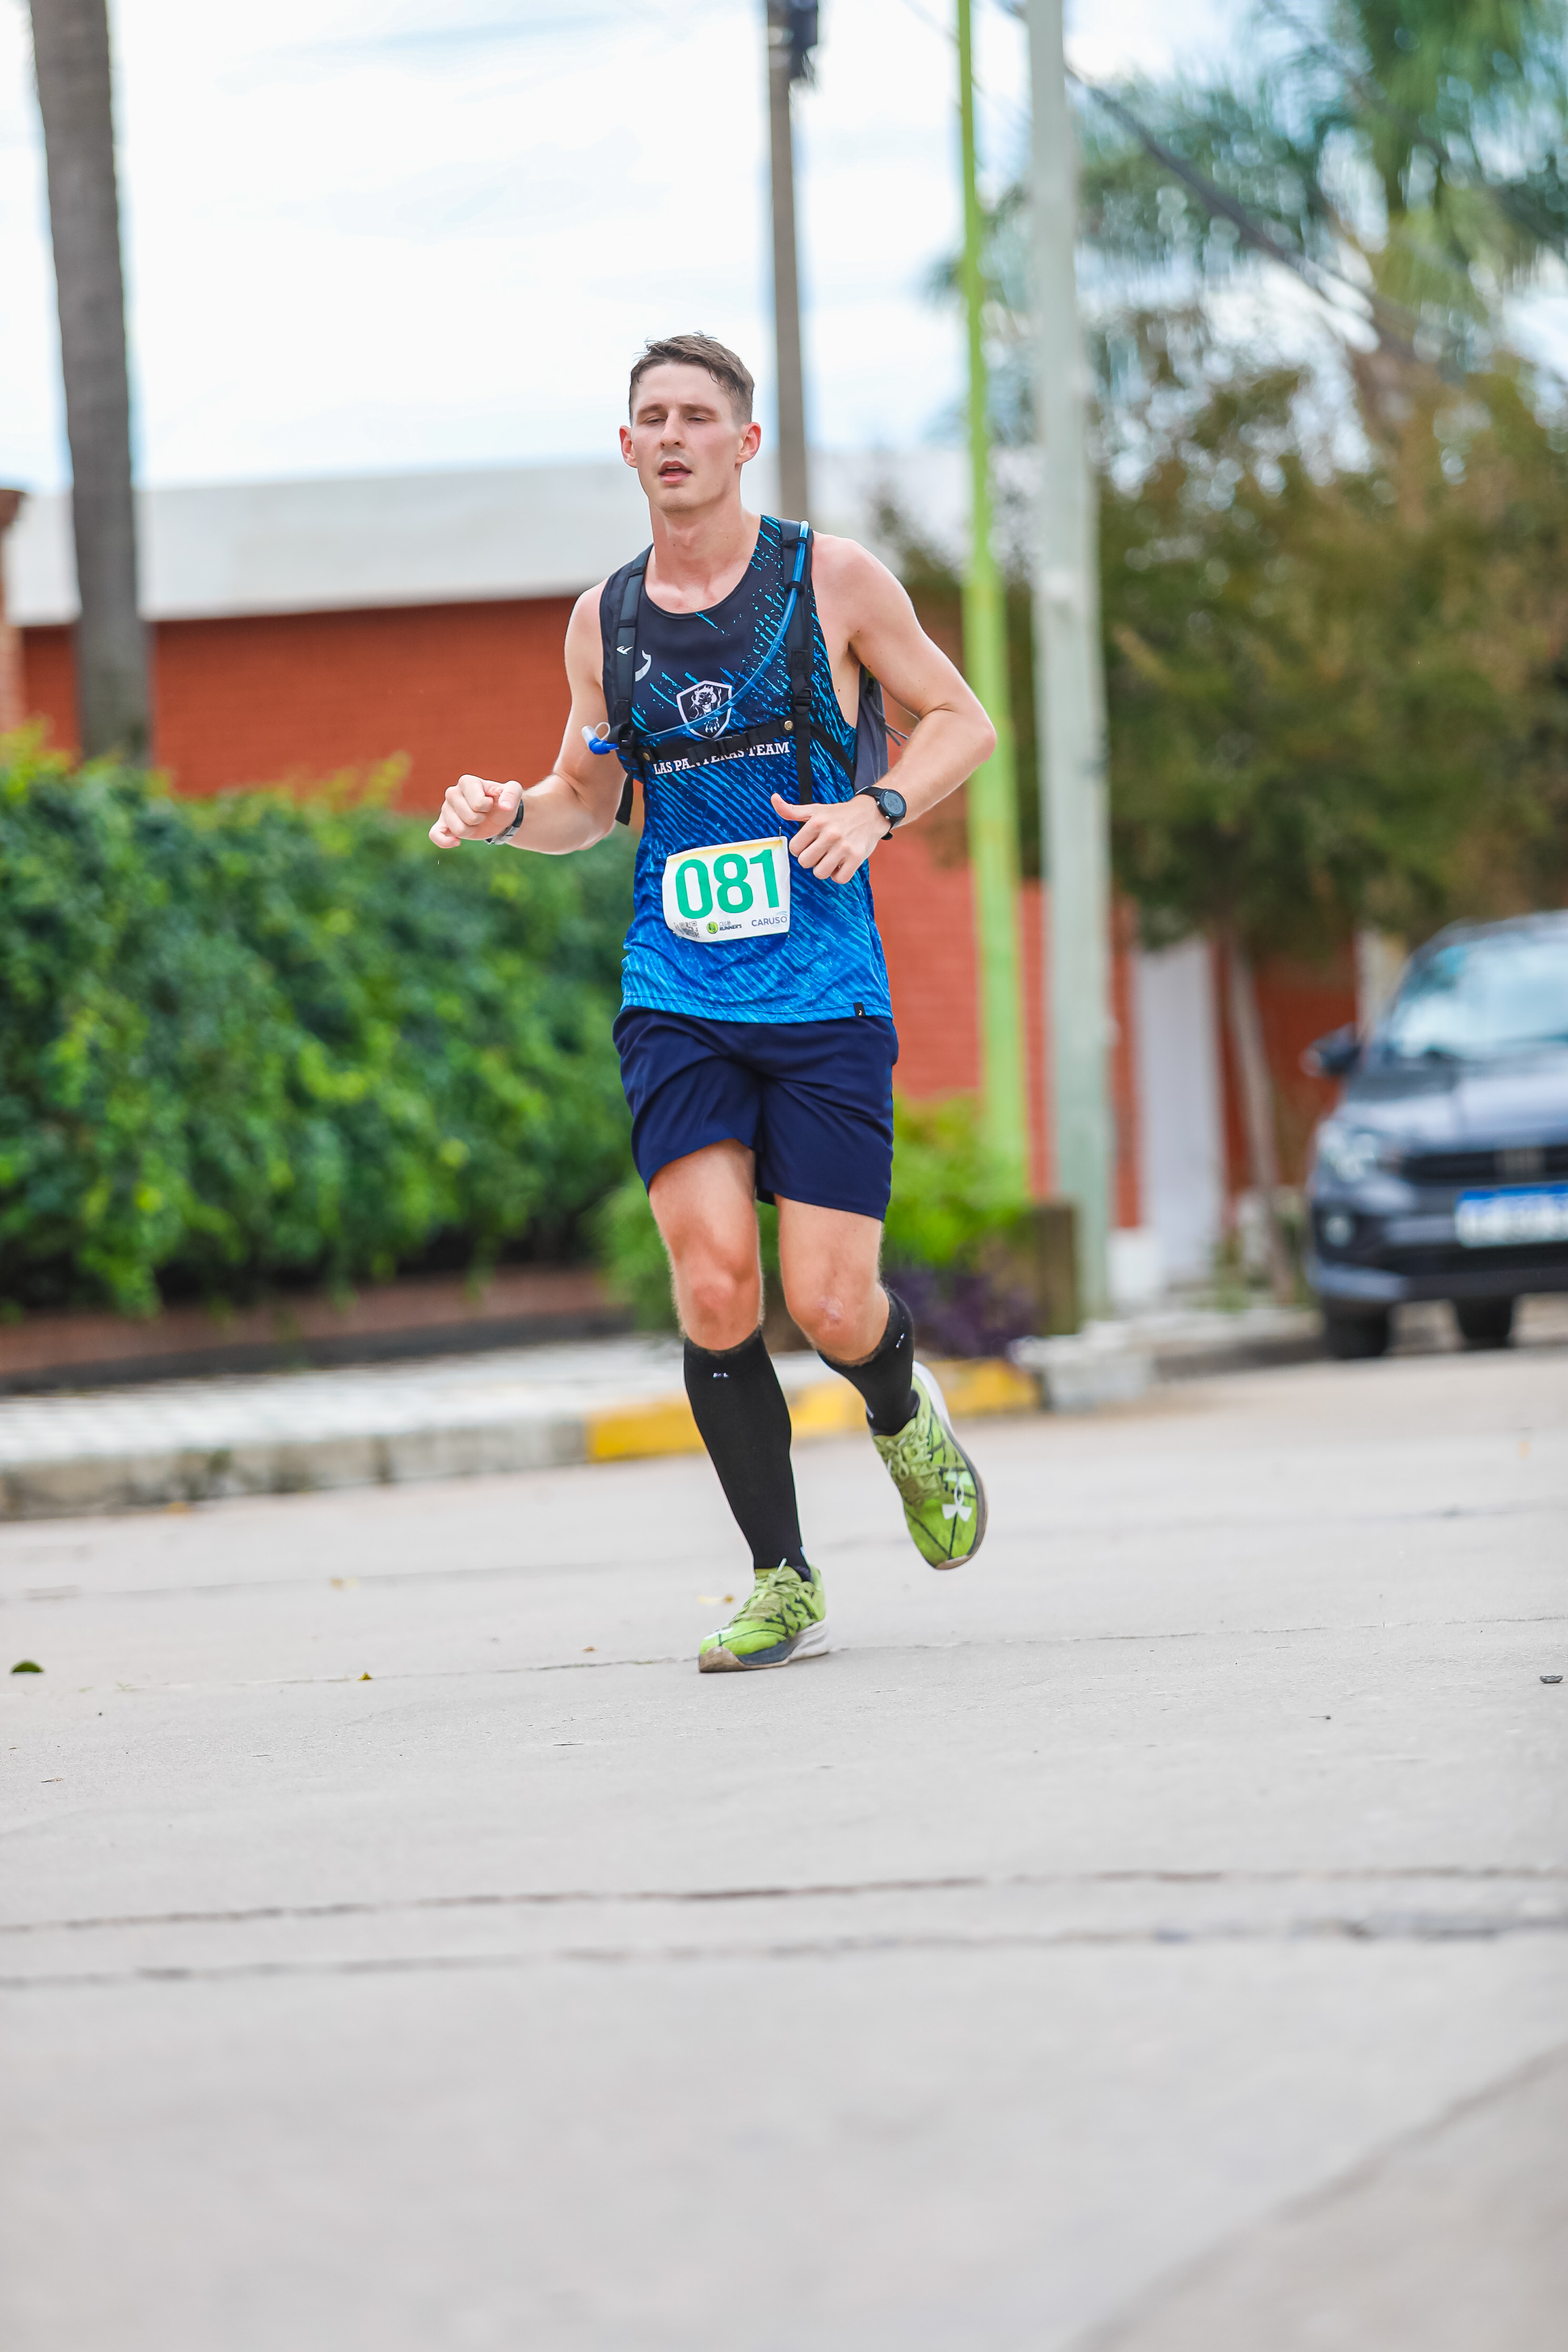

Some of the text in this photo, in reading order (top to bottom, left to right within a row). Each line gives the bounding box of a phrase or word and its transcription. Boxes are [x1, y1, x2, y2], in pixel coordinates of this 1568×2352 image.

[653, 741, 790, 775] LAS PAEAS TEAM
[675, 849, 779, 919] 081
[751, 916, 787, 926] CARUSO
